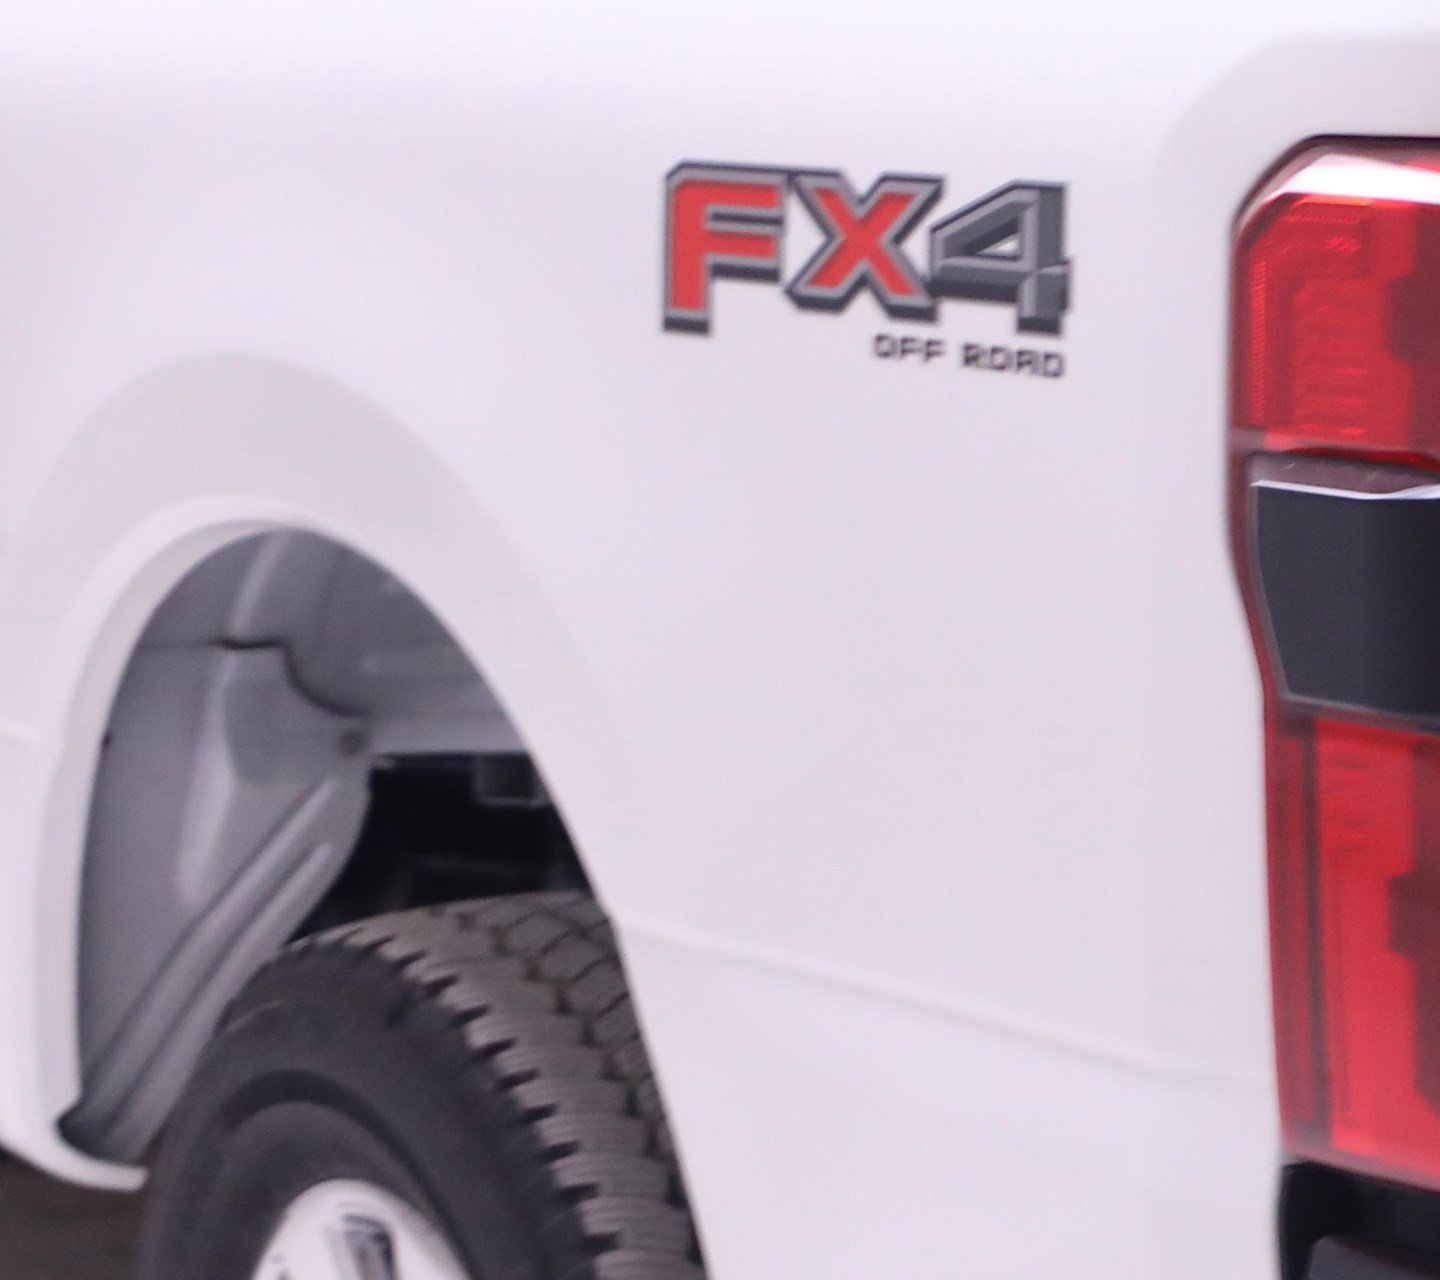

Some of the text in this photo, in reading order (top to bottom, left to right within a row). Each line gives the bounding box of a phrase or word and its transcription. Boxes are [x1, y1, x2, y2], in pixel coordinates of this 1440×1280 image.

[662, 159, 1072, 335] FX4
[873, 334, 1065, 378] OFF ROAD
